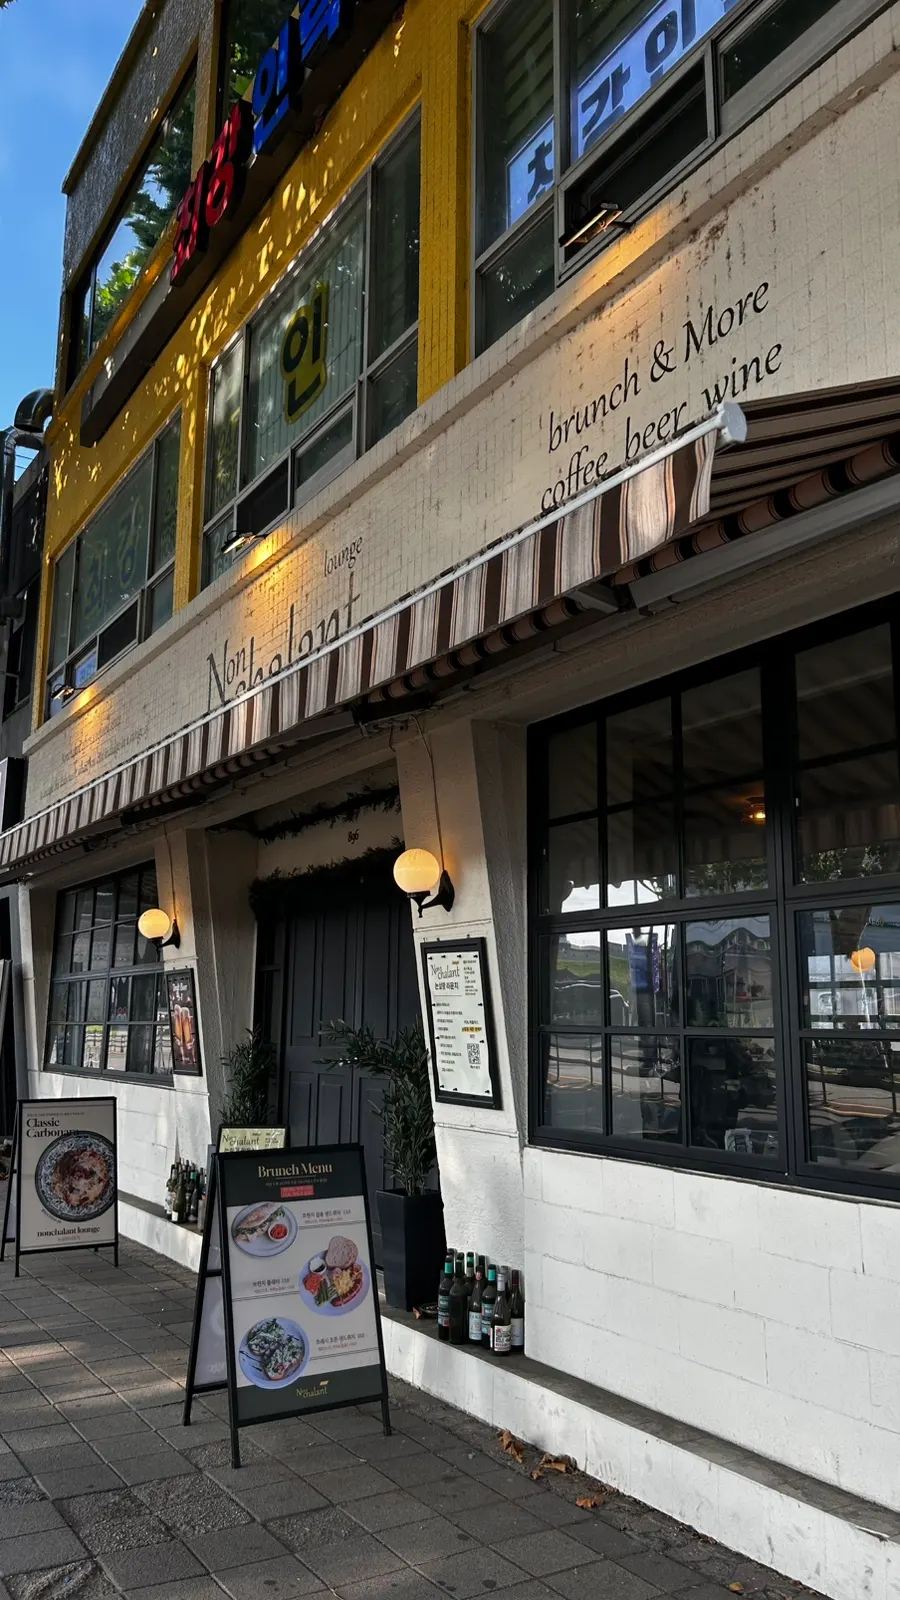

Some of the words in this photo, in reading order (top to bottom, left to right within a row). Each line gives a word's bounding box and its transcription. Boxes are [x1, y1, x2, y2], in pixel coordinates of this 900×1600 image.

[548, 358, 641, 453] brunch
[650, 340, 677, 383] &
[683, 282, 769, 362] More
[541, 445, 608, 512] coffee
[625, 401, 687, 461] beer
[702, 344, 782, 412] wine
[325, 536, 363, 577] lounge
[26, 1117, 60, 1128] Classic
[257, 1163, 299, 1178] Brunch
[300, 1162, 333, 1175] Menu
[36, 1227, 77, 1237] nonchalant
[77, 1225, 101, 1234] lounge
